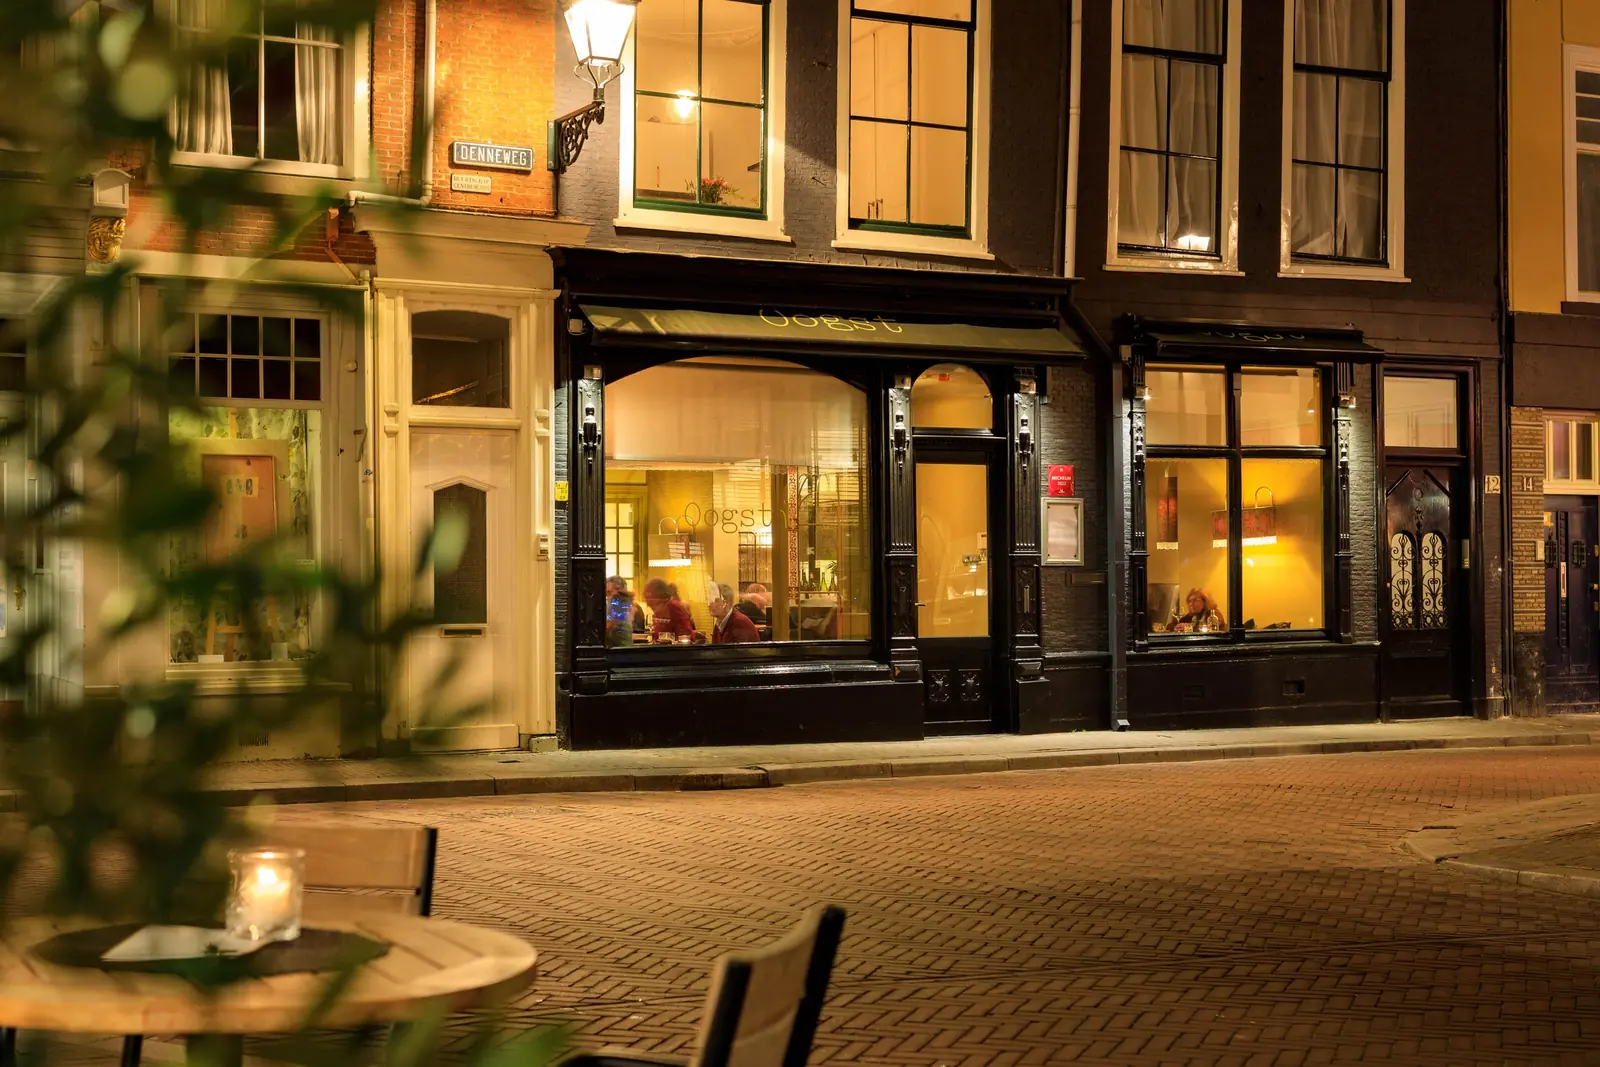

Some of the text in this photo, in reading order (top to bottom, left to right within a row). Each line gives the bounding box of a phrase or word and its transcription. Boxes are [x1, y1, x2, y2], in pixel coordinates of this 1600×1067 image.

[460, 145, 527, 166] DENNEWEG
[758, 308, 903, 334] Oogst
[1486, 476, 1500, 493] 12
[1523, 476, 1533, 491] 14
[684, 501, 772, 534] Oogst
